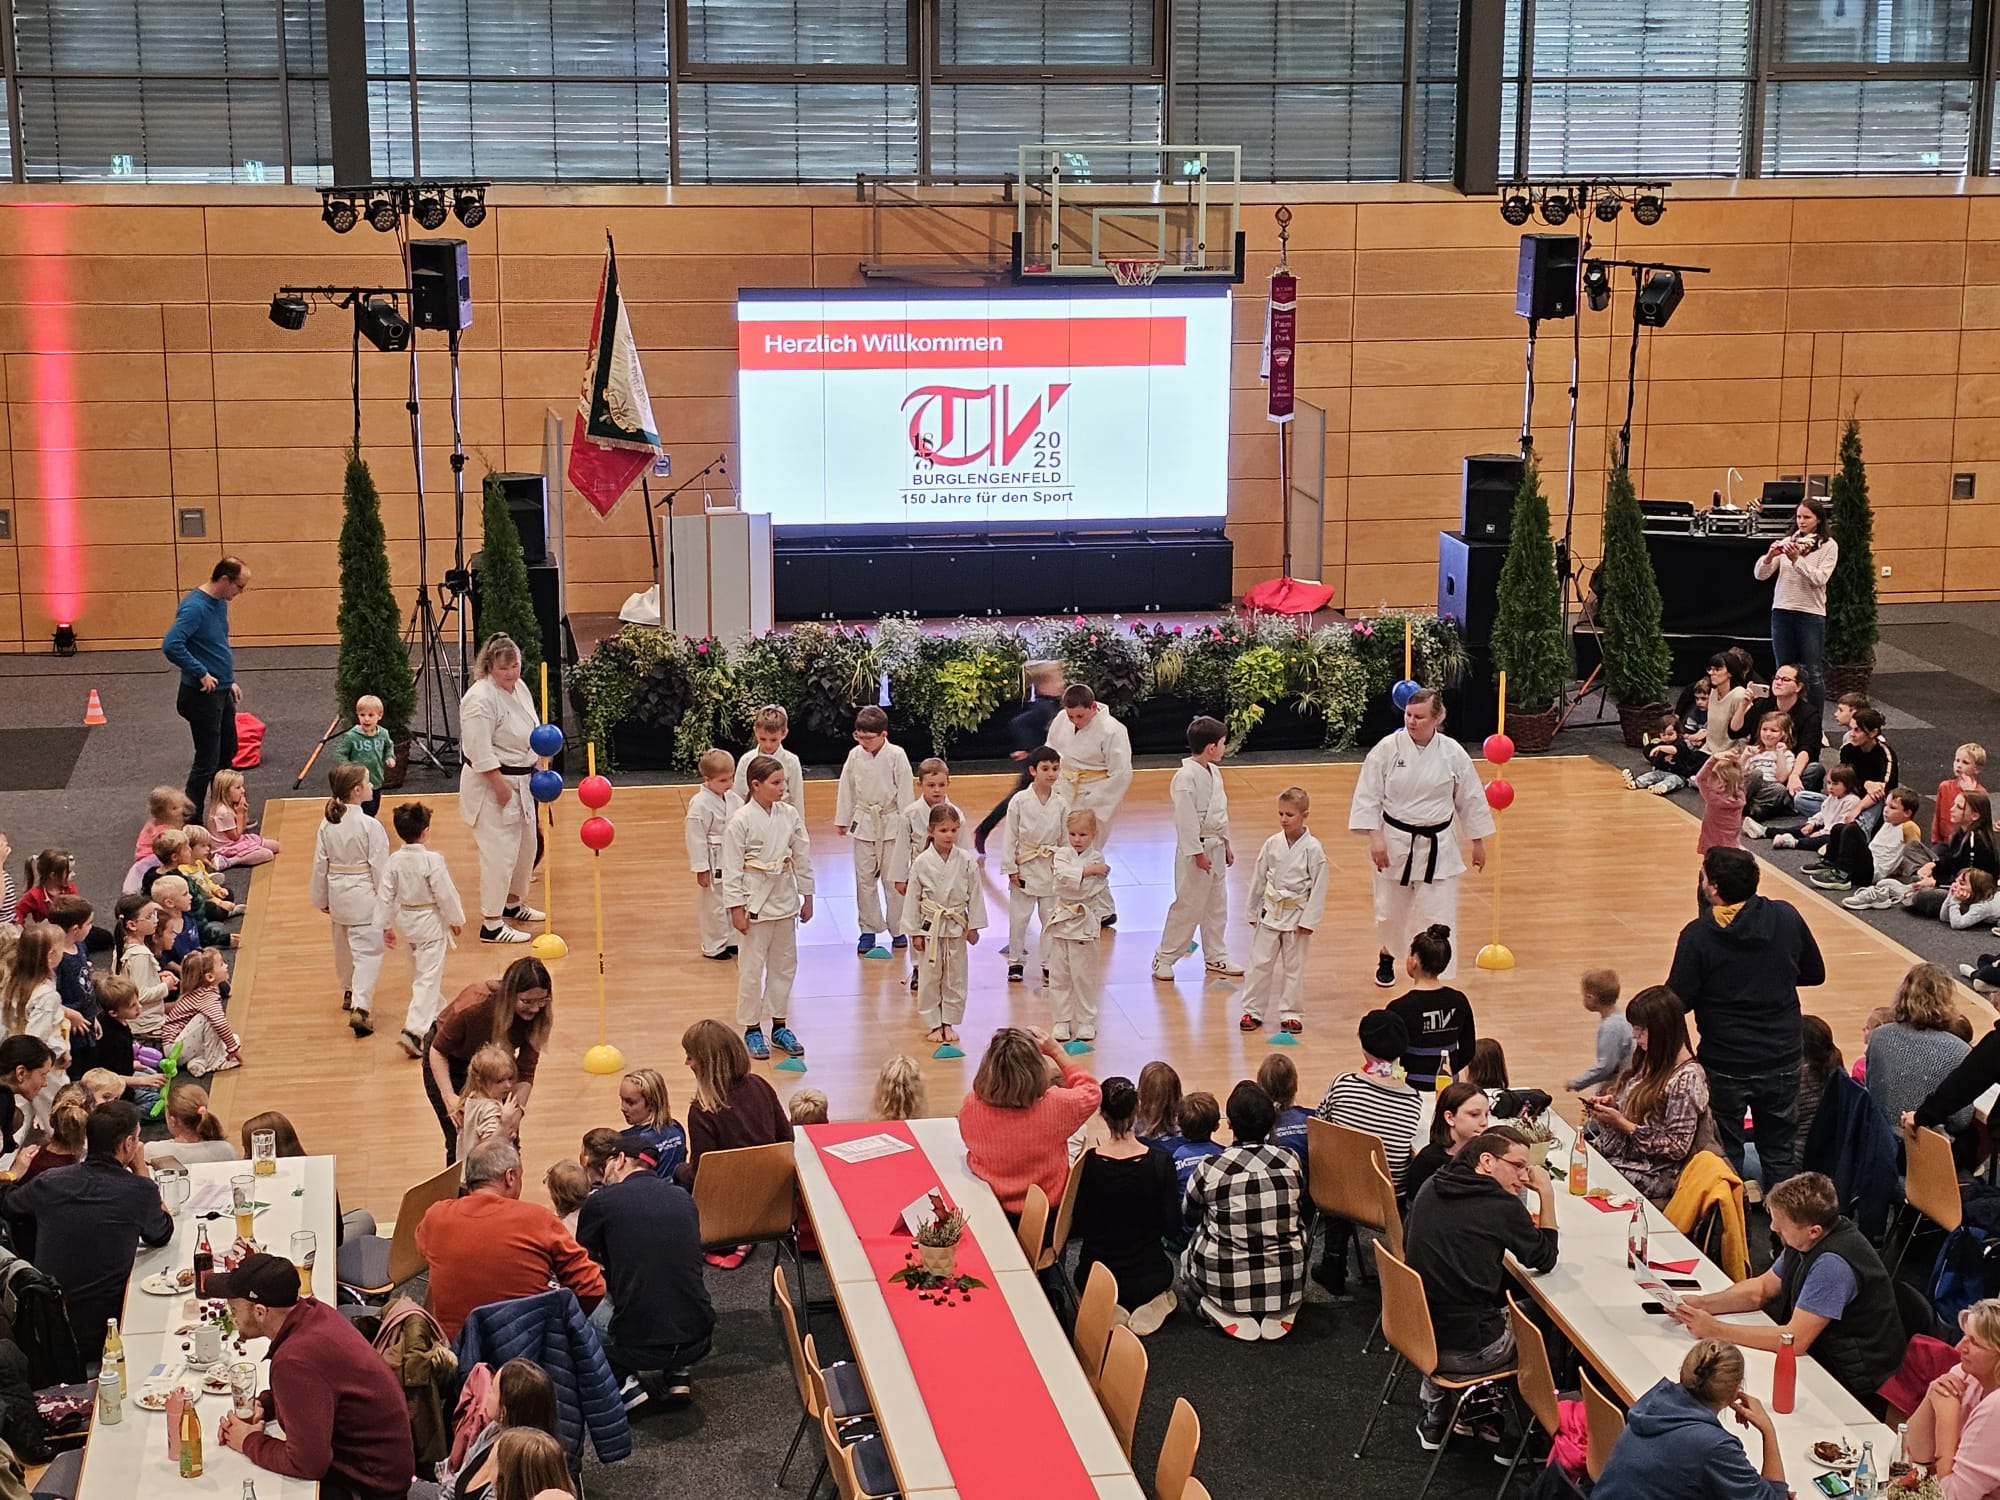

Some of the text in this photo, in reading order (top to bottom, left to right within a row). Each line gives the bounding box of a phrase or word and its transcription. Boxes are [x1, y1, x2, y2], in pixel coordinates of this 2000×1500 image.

[765, 333, 1003, 353] Herzlich Willkommen
[913, 432, 934, 451] 18
[1034, 431, 1061, 449] 20
[1034, 451, 1061, 469] 25
[913, 472, 1062, 485] BURGLENGENFELD
[901, 491, 1073, 505] 150 Jahre für den Sport
[352, 739, 371, 752] US
